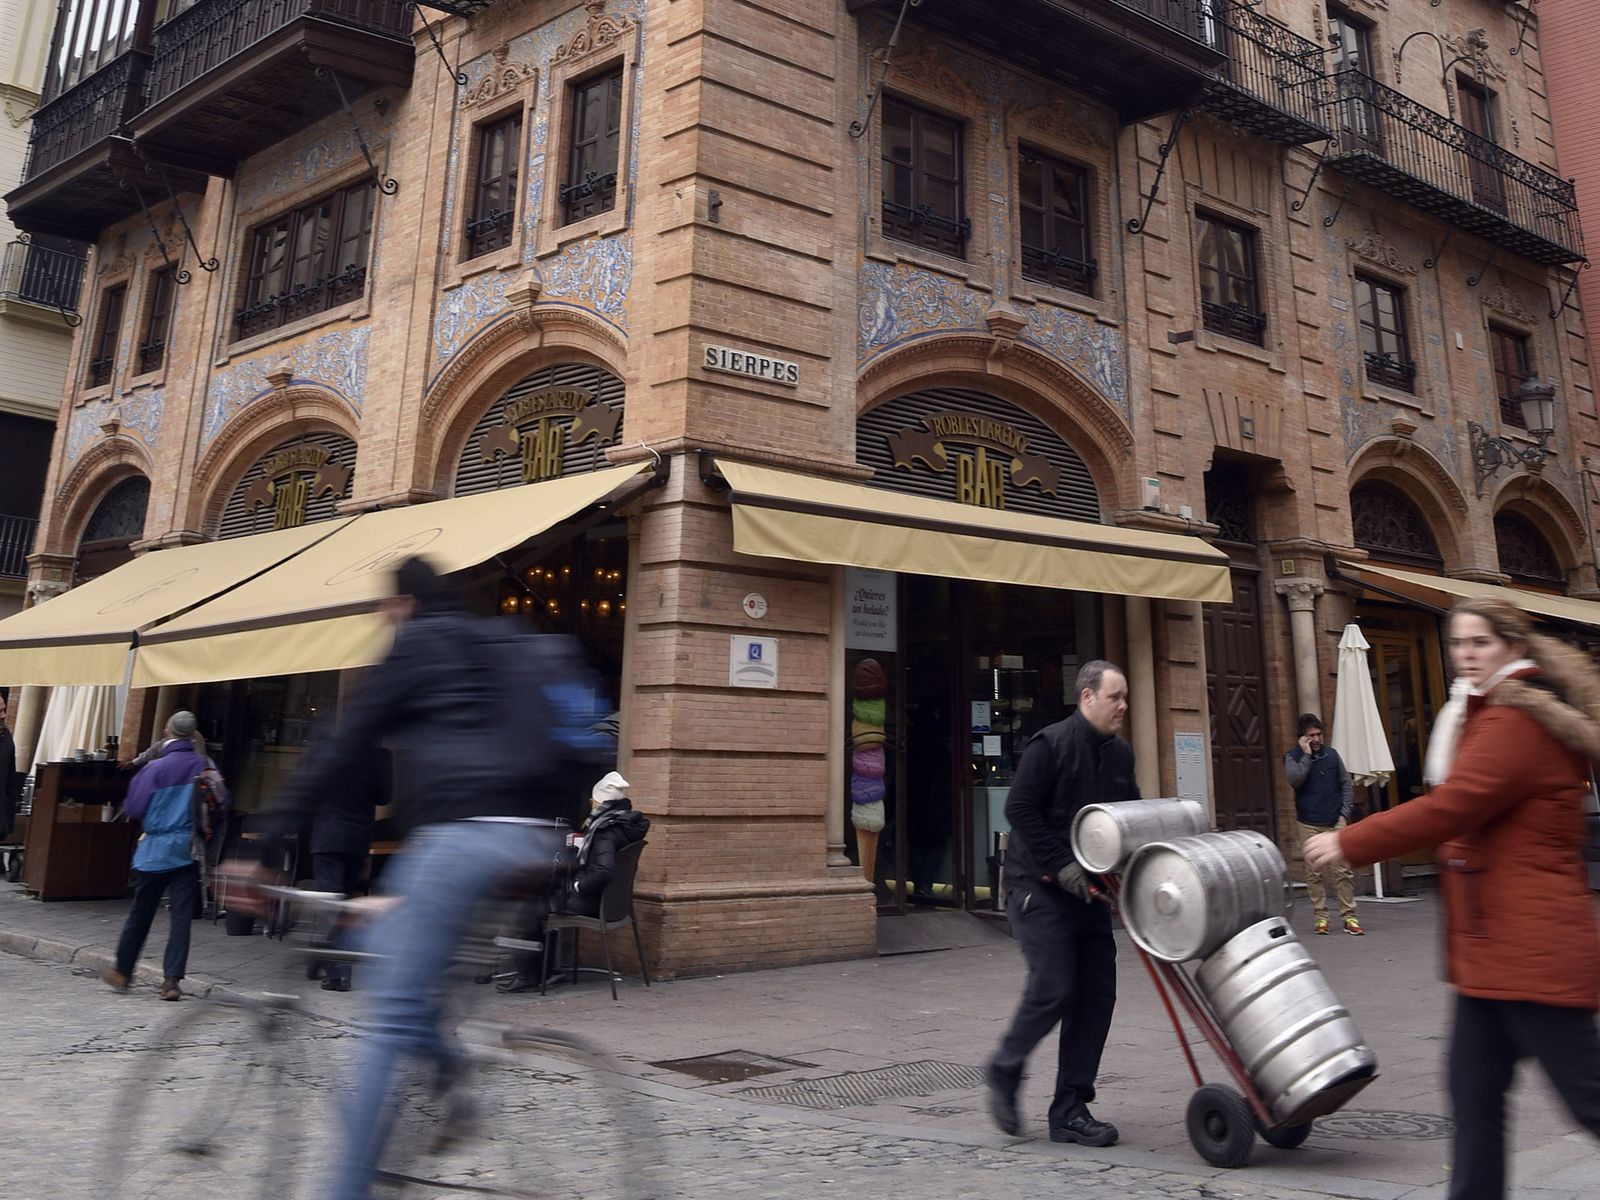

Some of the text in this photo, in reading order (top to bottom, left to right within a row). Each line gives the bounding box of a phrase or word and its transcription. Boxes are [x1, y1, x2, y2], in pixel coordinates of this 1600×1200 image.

[706, 347, 798, 382] SIERPES
[521, 416, 563, 481] BAR
[956, 447, 1005, 510] BAR
